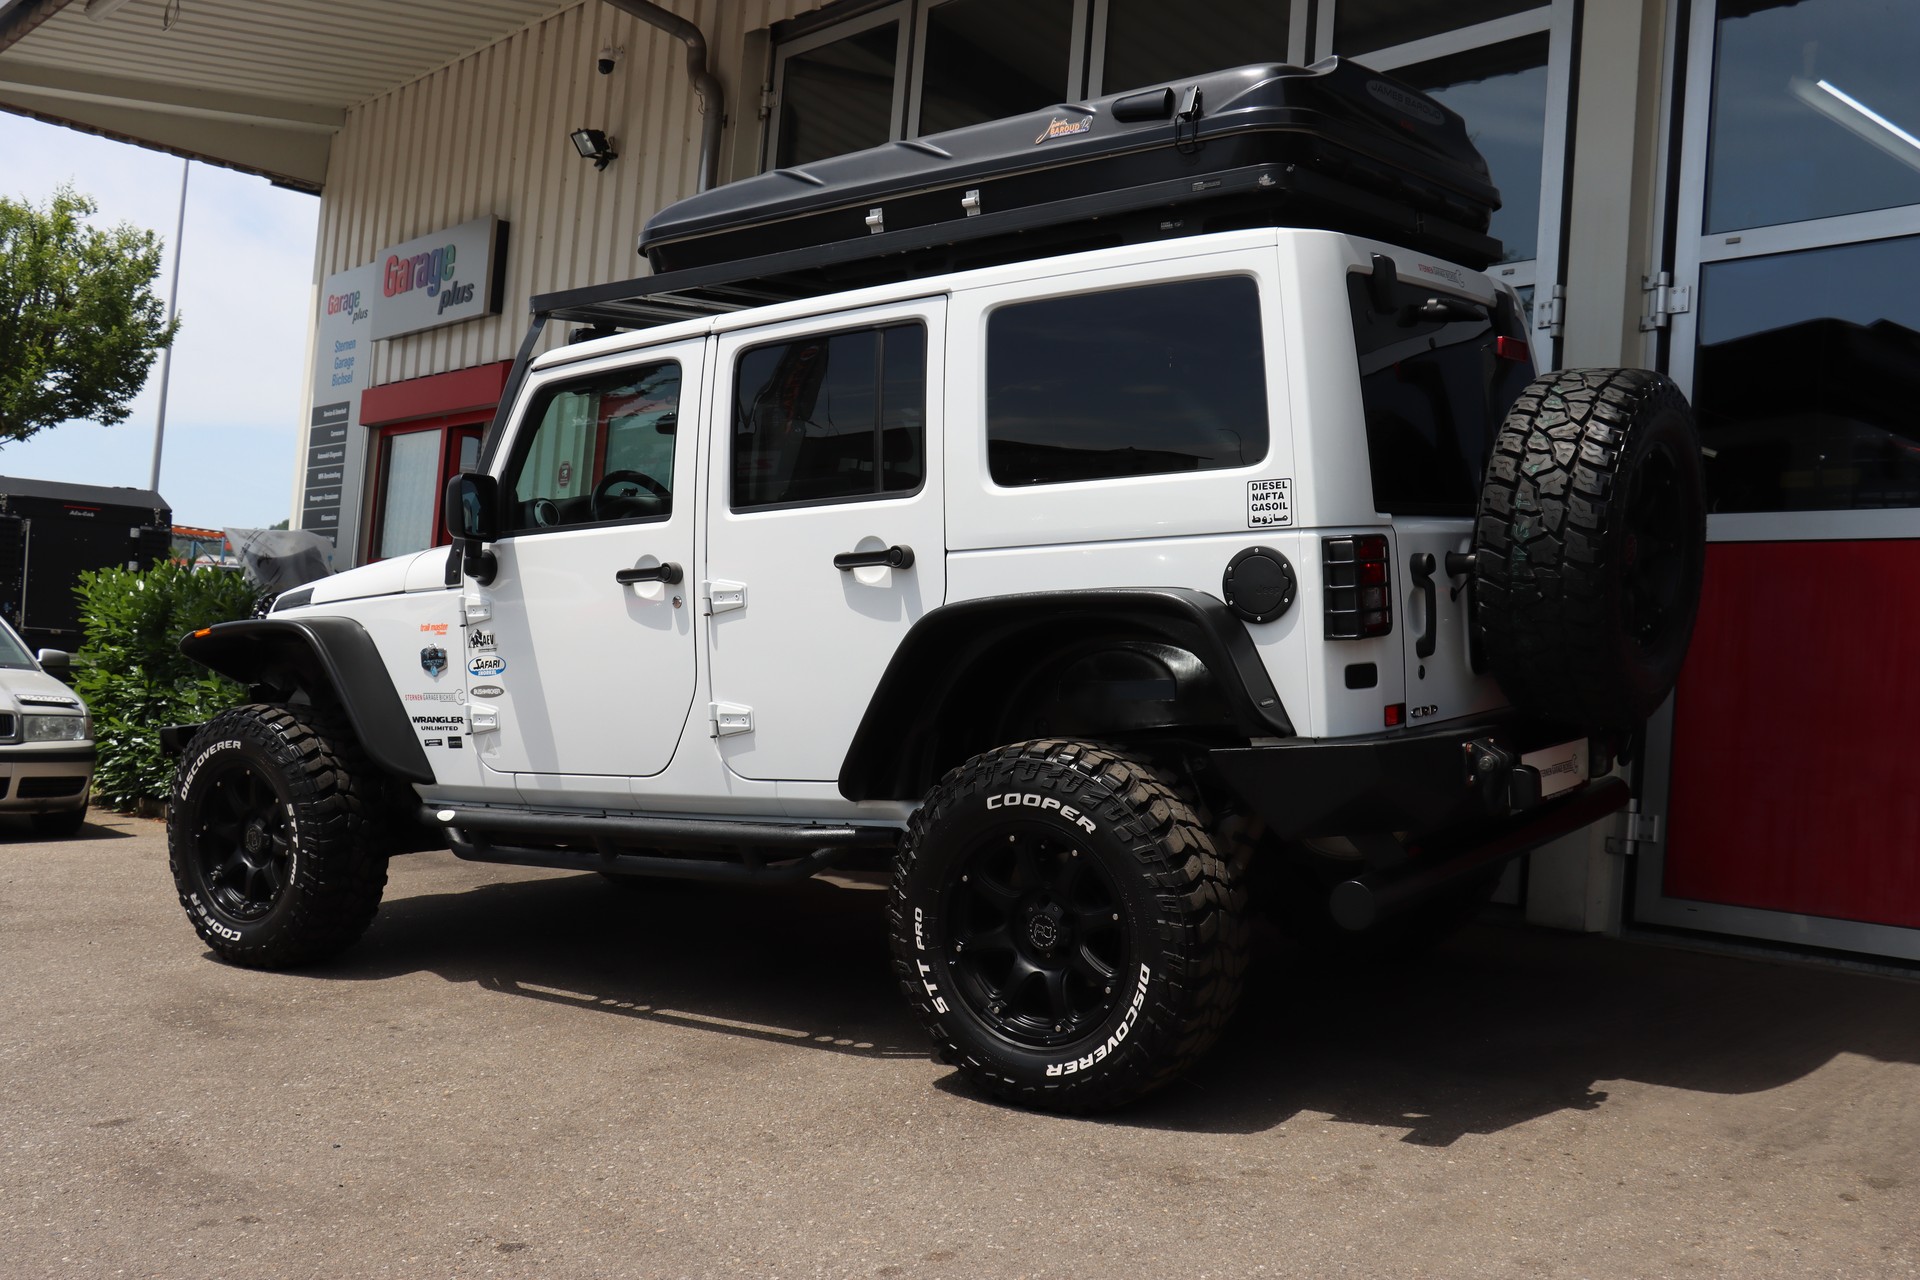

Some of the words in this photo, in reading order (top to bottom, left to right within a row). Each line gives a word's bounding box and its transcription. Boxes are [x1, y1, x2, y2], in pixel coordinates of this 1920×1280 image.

[1050, 123, 1080, 135] BAROUD
[383, 243, 456, 298] Garage
[327, 290, 361, 316] Garage
[437, 280, 475, 315] plus
[352, 307, 369, 325] plus
[334, 339, 357, 353] Sternen
[334, 356, 355, 370] Garage
[331, 370, 354, 387] Bichsel
[1251, 481, 1288, 491] DIESEL
[1252, 491, 1285, 501] NAFTA
[1251, 502, 1289, 512] GASOIL
[483, 633, 495, 645] AEV
[473, 658, 500, 670] SAFARI
[411, 716, 464, 724] WRANGLER
[180, 739, 242, 801] DISCOVERER
[986, 792, 1097, 835] COOPER
[285, 803, 299, 849] STT
[289, 852, 298, 886] PRO
[190, 892, 242, 942] COOPER
[914, 906, 924, 951] PRO
[915, 958, 951, 1014] STT
[1046, 962, 1151, 1078] DISCOVERER
